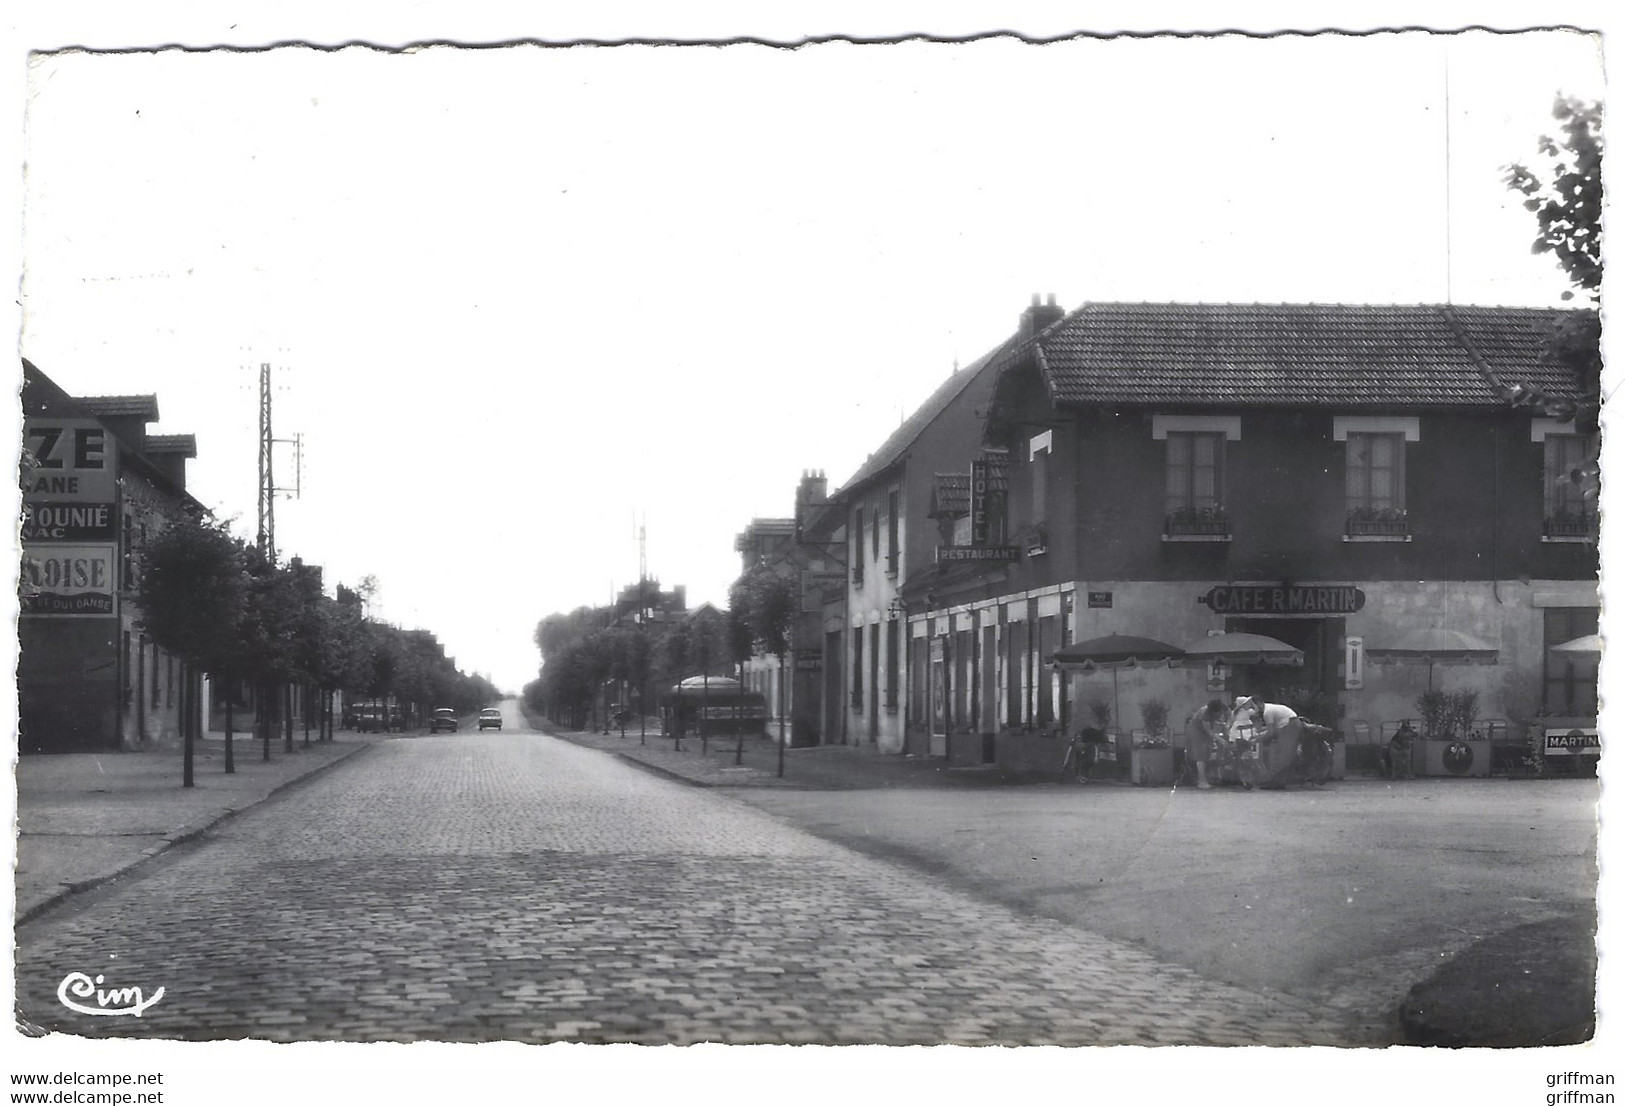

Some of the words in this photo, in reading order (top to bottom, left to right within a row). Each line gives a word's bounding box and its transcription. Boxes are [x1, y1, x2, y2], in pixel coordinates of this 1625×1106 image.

[974, 465, 987, 542] HOTEL
[941, 549, 1016, 560] RESTAURANT
[76, 598, 111, 610] DANSE
[1213, 588, 1265, 611] CAFE
